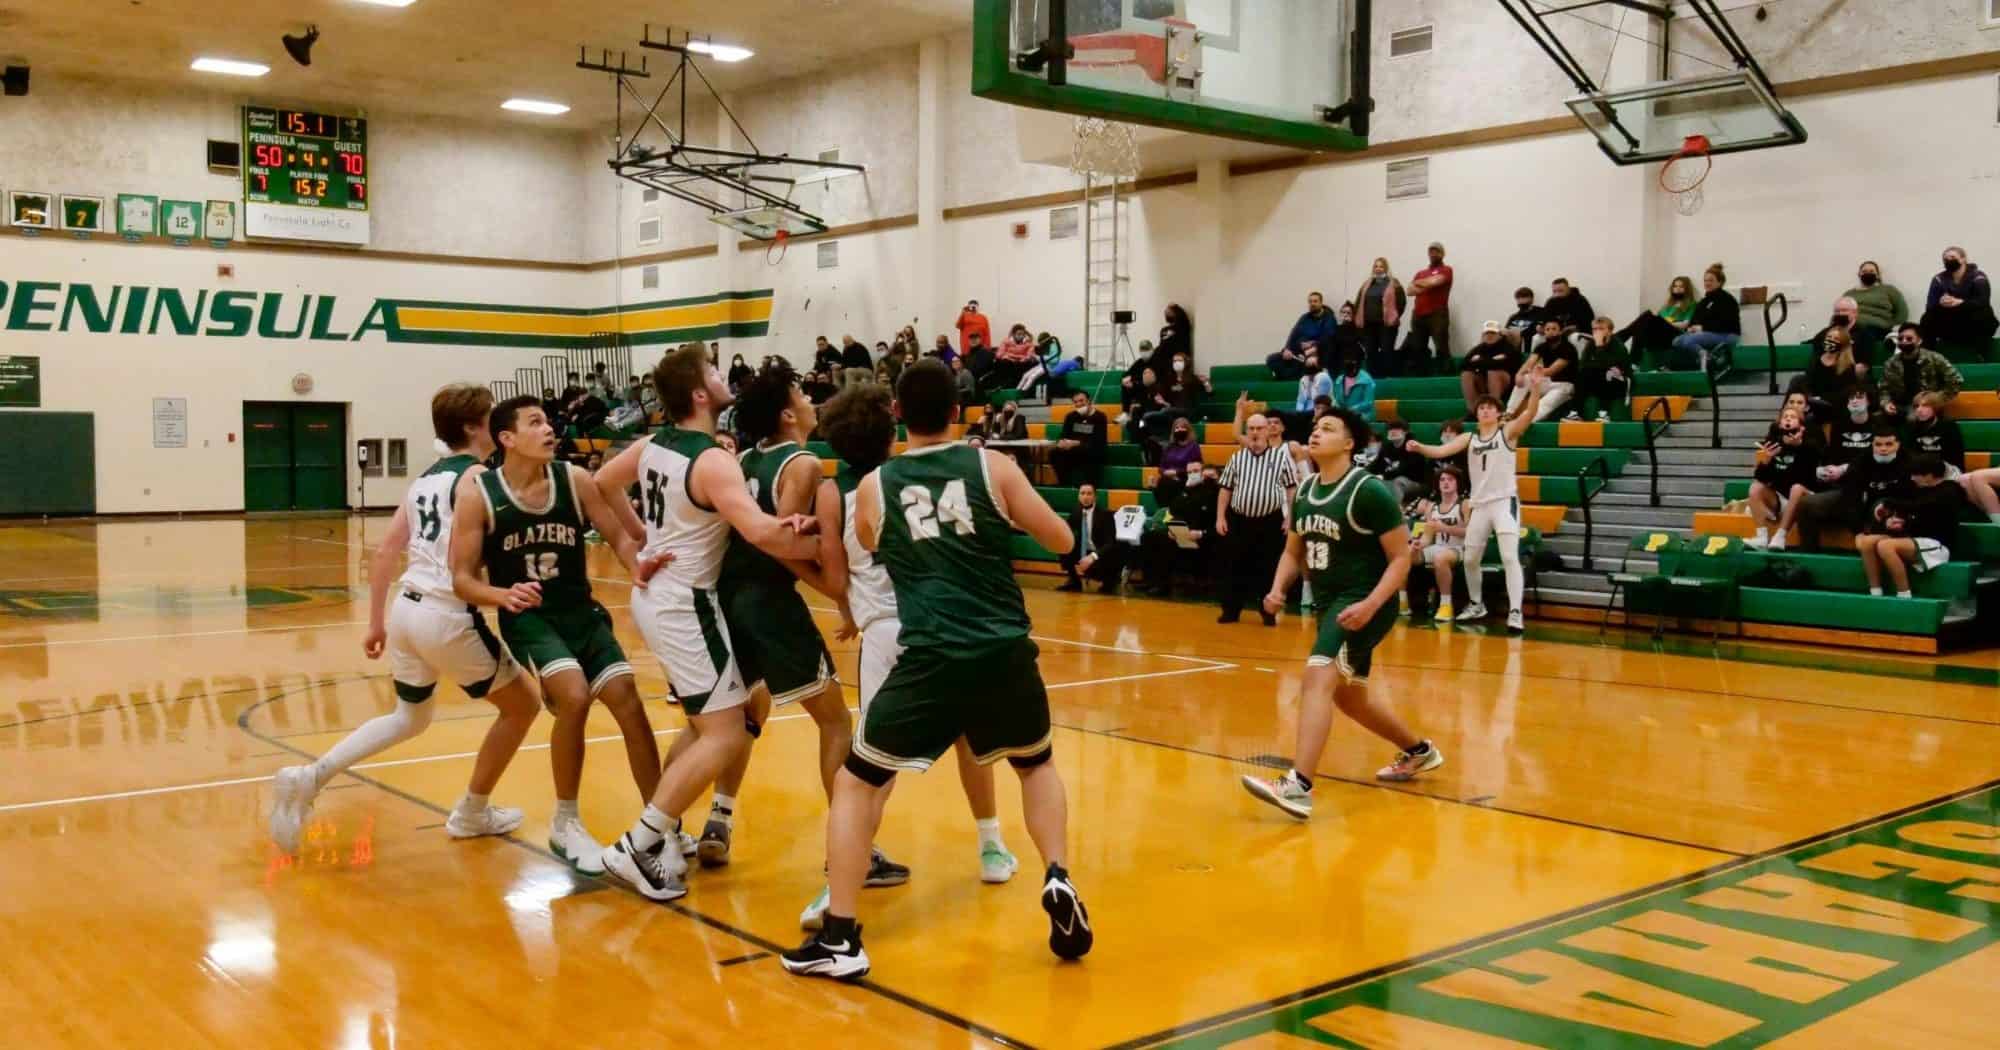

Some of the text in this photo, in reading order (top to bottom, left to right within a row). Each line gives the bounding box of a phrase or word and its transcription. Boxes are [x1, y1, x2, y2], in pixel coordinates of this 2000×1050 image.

[249, 132, 296, 146] PENINSULA
[334, 141, 362, 153] GUEST
[256, 145, 282, 167] 50
[303, 152, 314, 167] 4
[340, 153, 364, 175] 70
[257, 173, 267, 192] 7
[353, 182, 364, 199] 7
[76, 210, 87, 226] 7
[175, 215, 189, 229] 12
[0, 280, 401, 344] ENINSULA
[1482, 453, 1487, 472] 1
[900, 478, 977, 542] 24
[503, 522, 577, 552] BLAZERS
[1644, 532, 1669, 552] P
[1703, 536, 1729, 556] P
[524, 551, 560, 581] 12
